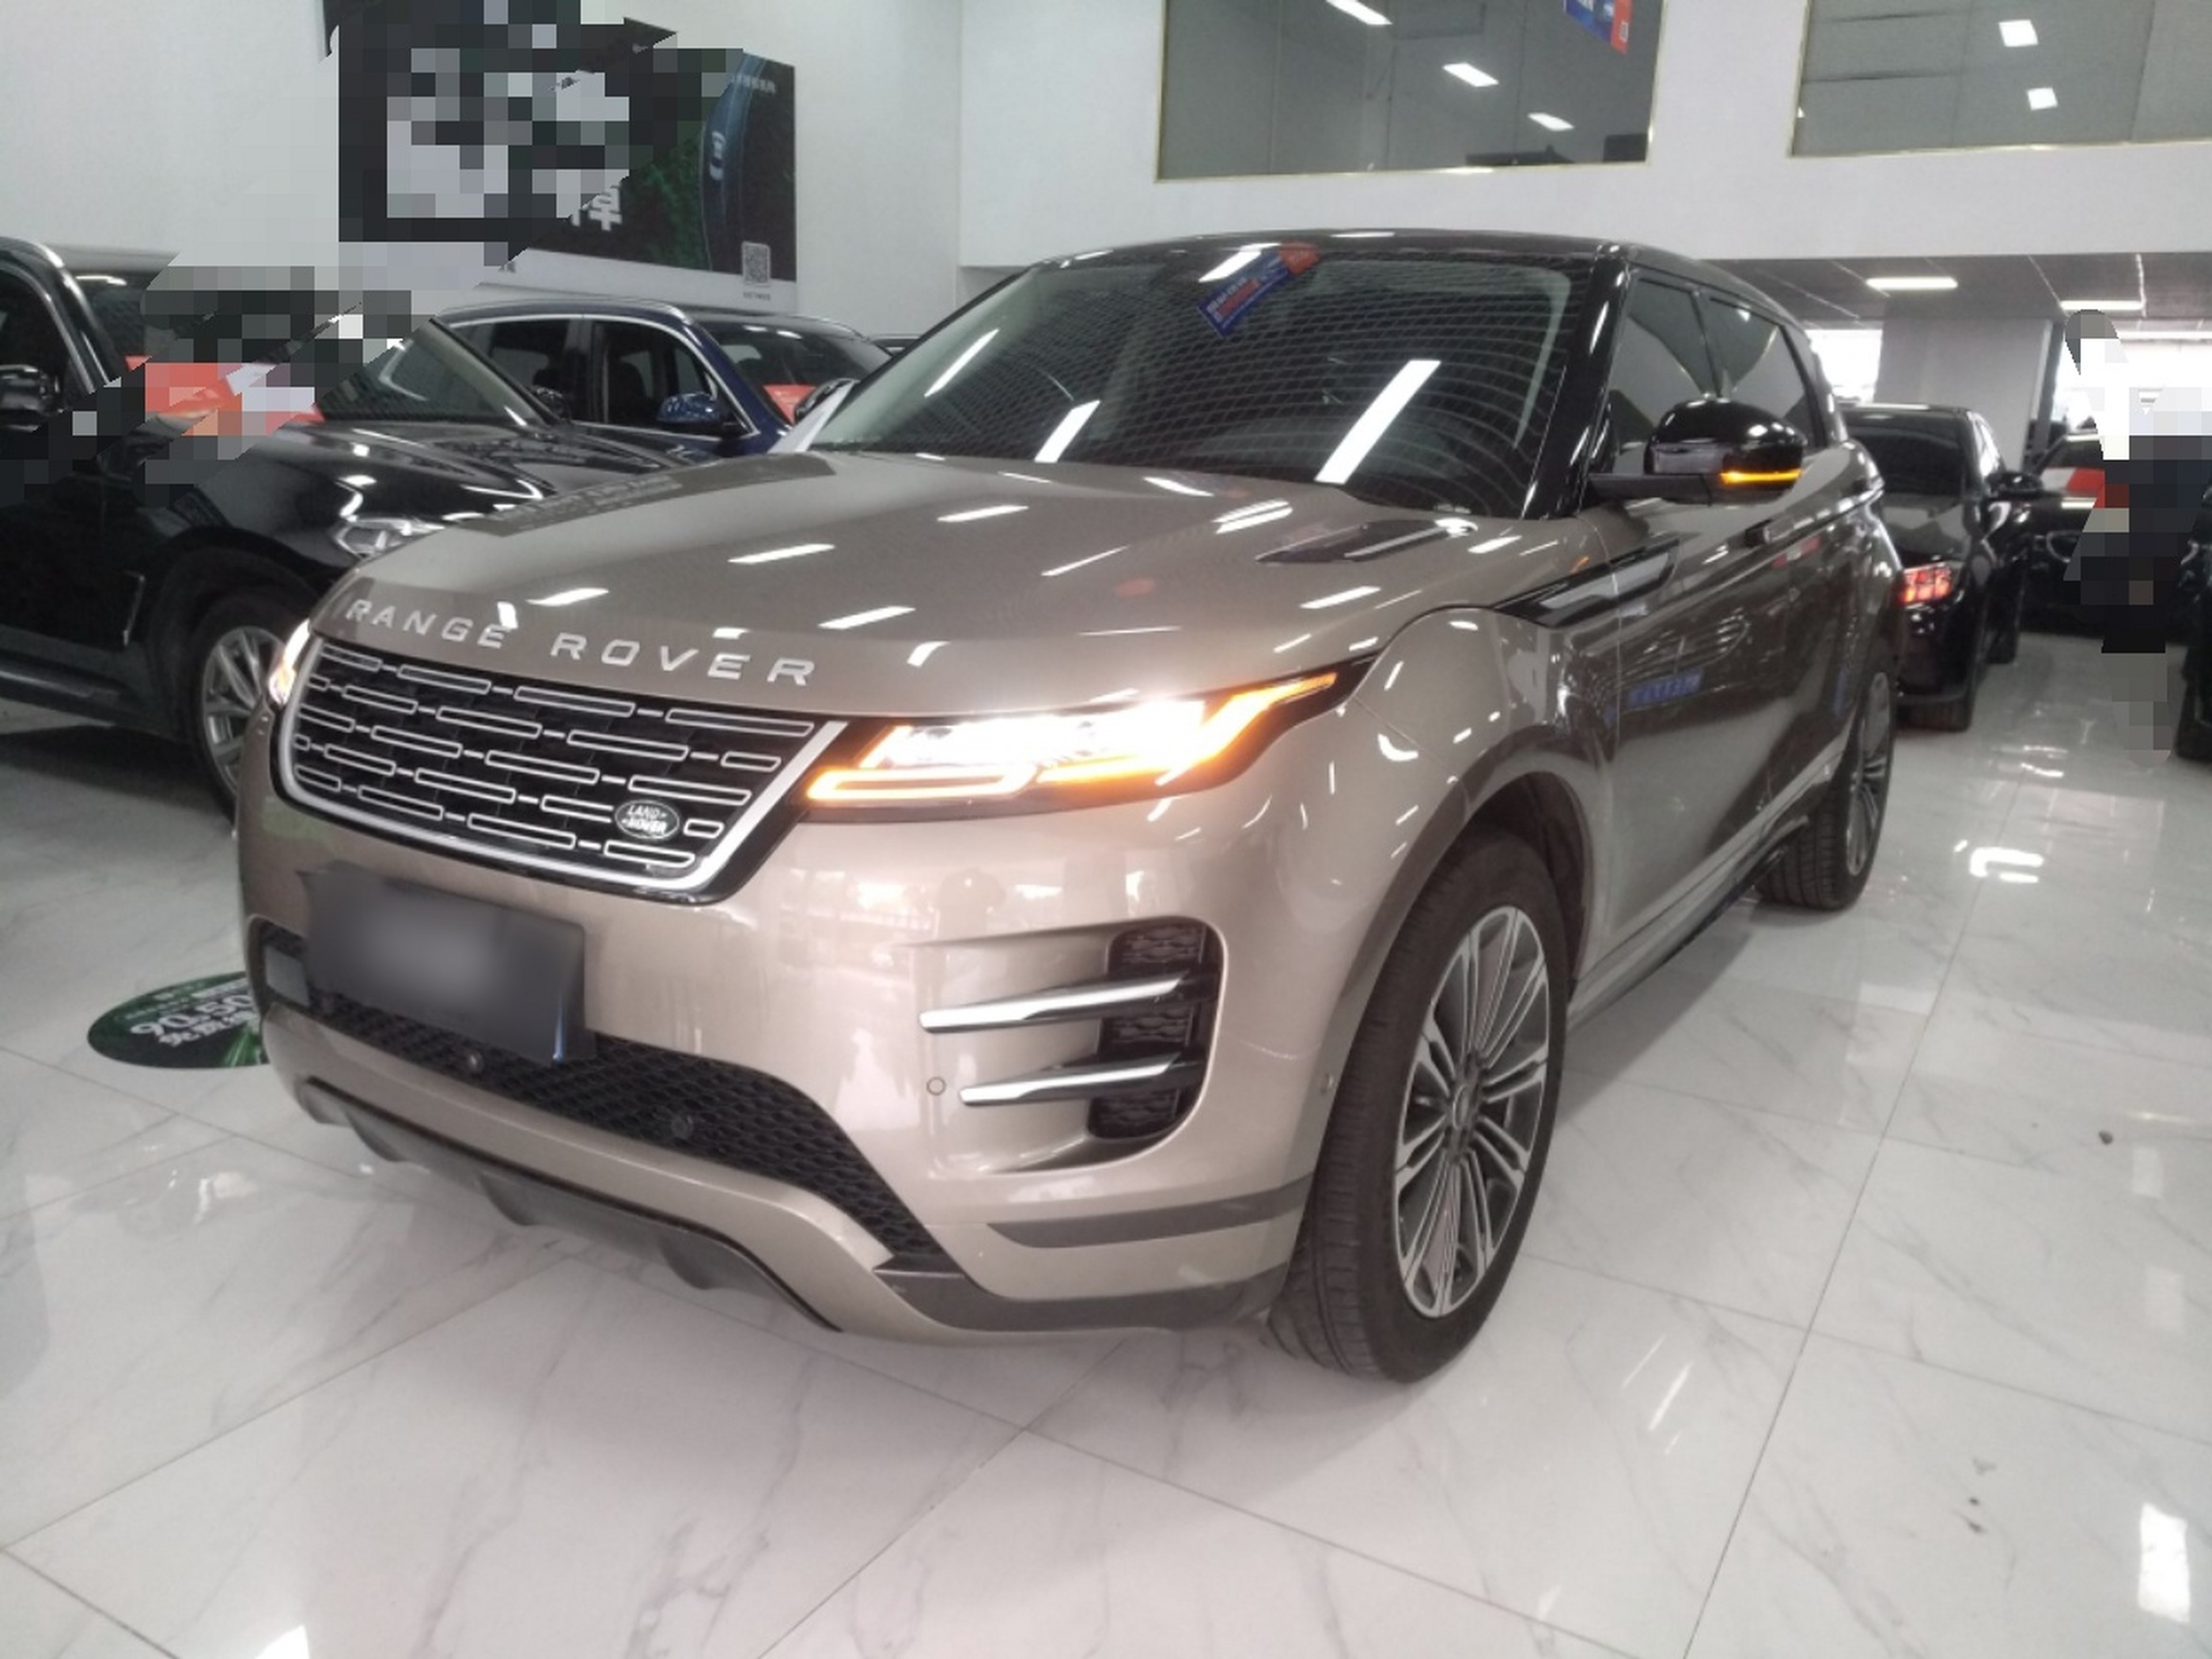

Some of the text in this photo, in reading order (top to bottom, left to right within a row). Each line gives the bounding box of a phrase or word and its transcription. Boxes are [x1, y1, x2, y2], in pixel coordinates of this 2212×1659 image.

[346, 599, 815, 686] RANGE ROVER
[627, 805, 660, 819] LAND
